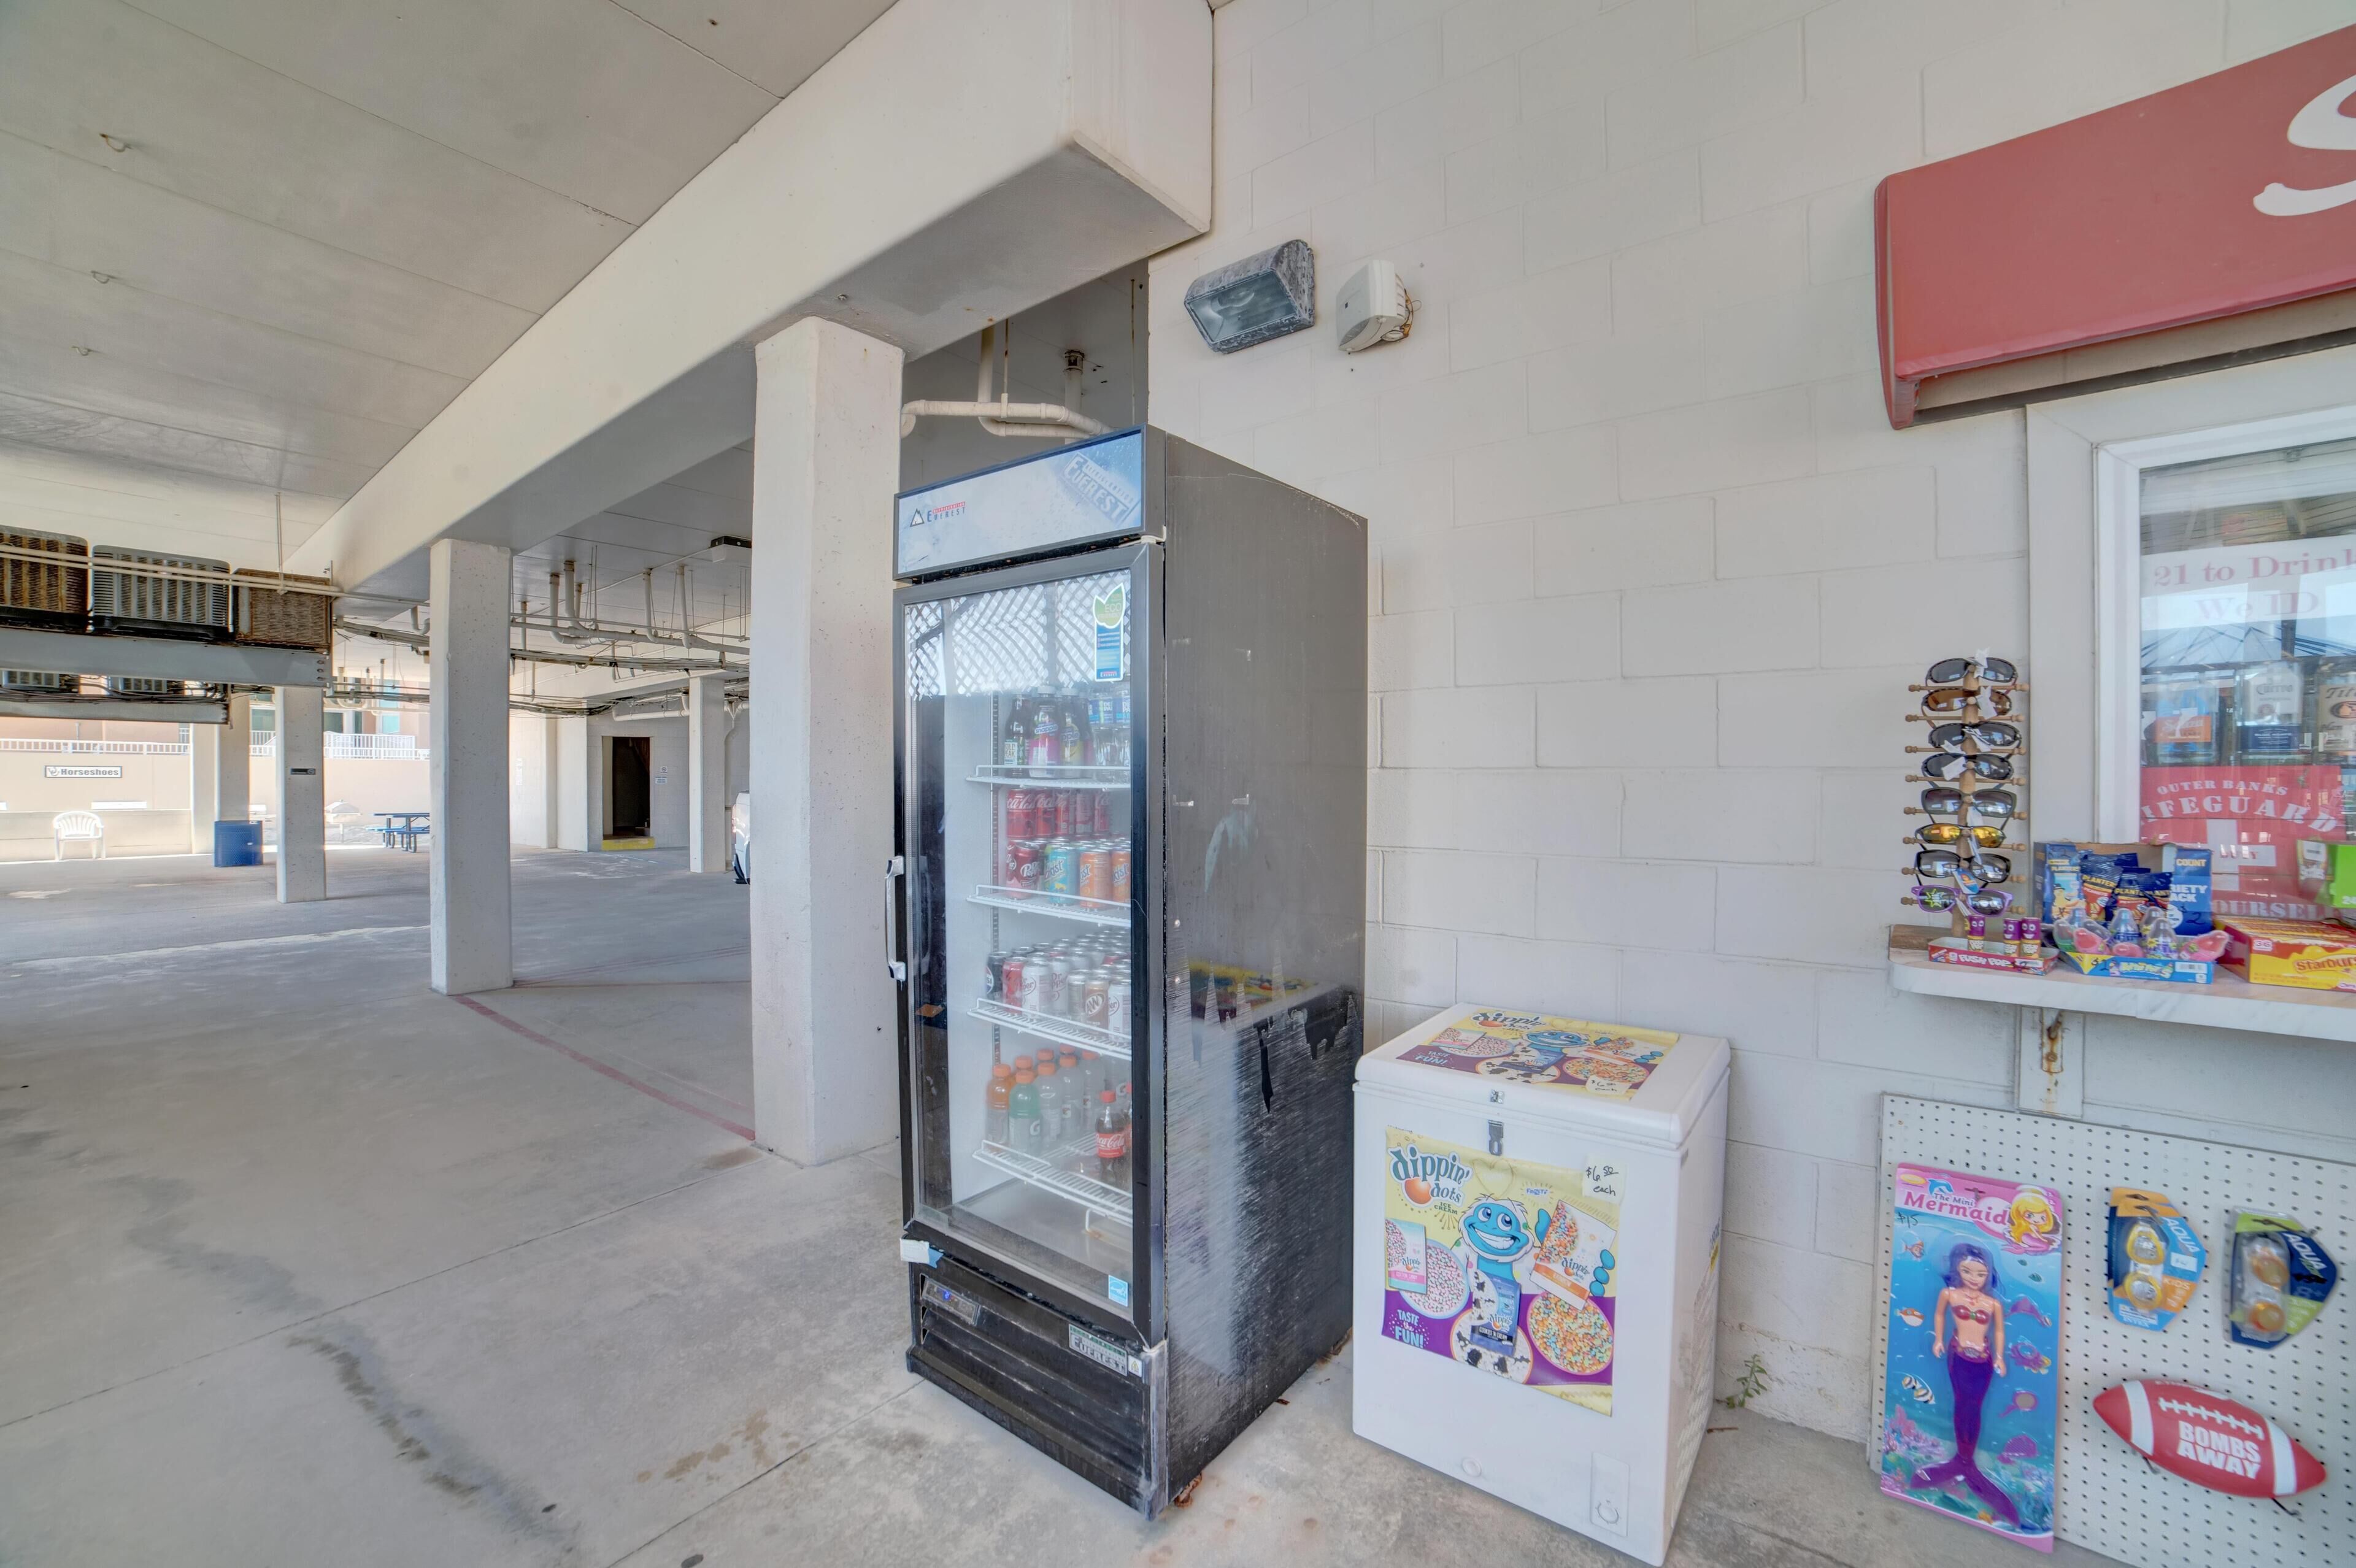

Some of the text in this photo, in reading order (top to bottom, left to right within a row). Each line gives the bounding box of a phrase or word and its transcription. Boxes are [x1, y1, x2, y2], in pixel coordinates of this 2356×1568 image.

[2154, 563, 2190, 585] 21
[2201, 559, 2235, 582] to
[1104, 602, 1122, 613] ECO
[2195, 591, 2318, 620] We ID
[2157, 780, 2288, 796] OUTER BANKS
[2141, 796, 2337, 832] IFEGUARD
[2082, 874, 2116, 888] PLANTER
[2171, 884, 2208, 894] RIETY
[2170, 893, 2197, 902] ACK
[2255, 939, 2271, 948] 36
[1958, 954, 1987, 965] PUSH
[1987, 958, 2011, 967] POP
[1472, 1013, 1547, 1026] dippin'
[1417, 1055, 1448, 1065] FUN!
[1390, 1146, 1470, 1185] dippin'
[1430, 1182, 1461, 1203] dots
[1593, 1185, 1616, 1196] each
[1904, 1191, 2008, 1225] Mermaid
[1934, 1193, 1974, 1207] The Mini
[1434, 1205, 1458, 1215] CREAM
[2162, 1217, 2201, 1253] AQUA
[2282, 1232, 2327, 1270] AQUA
[1397, 1309, 1420, 1326] TASTE
[1395, 1326, 1423, 1349] FUN!
[2179, 1420, 2261, 1463] BOMBS
[2176, 1439, 2261, 1480] AWAY
